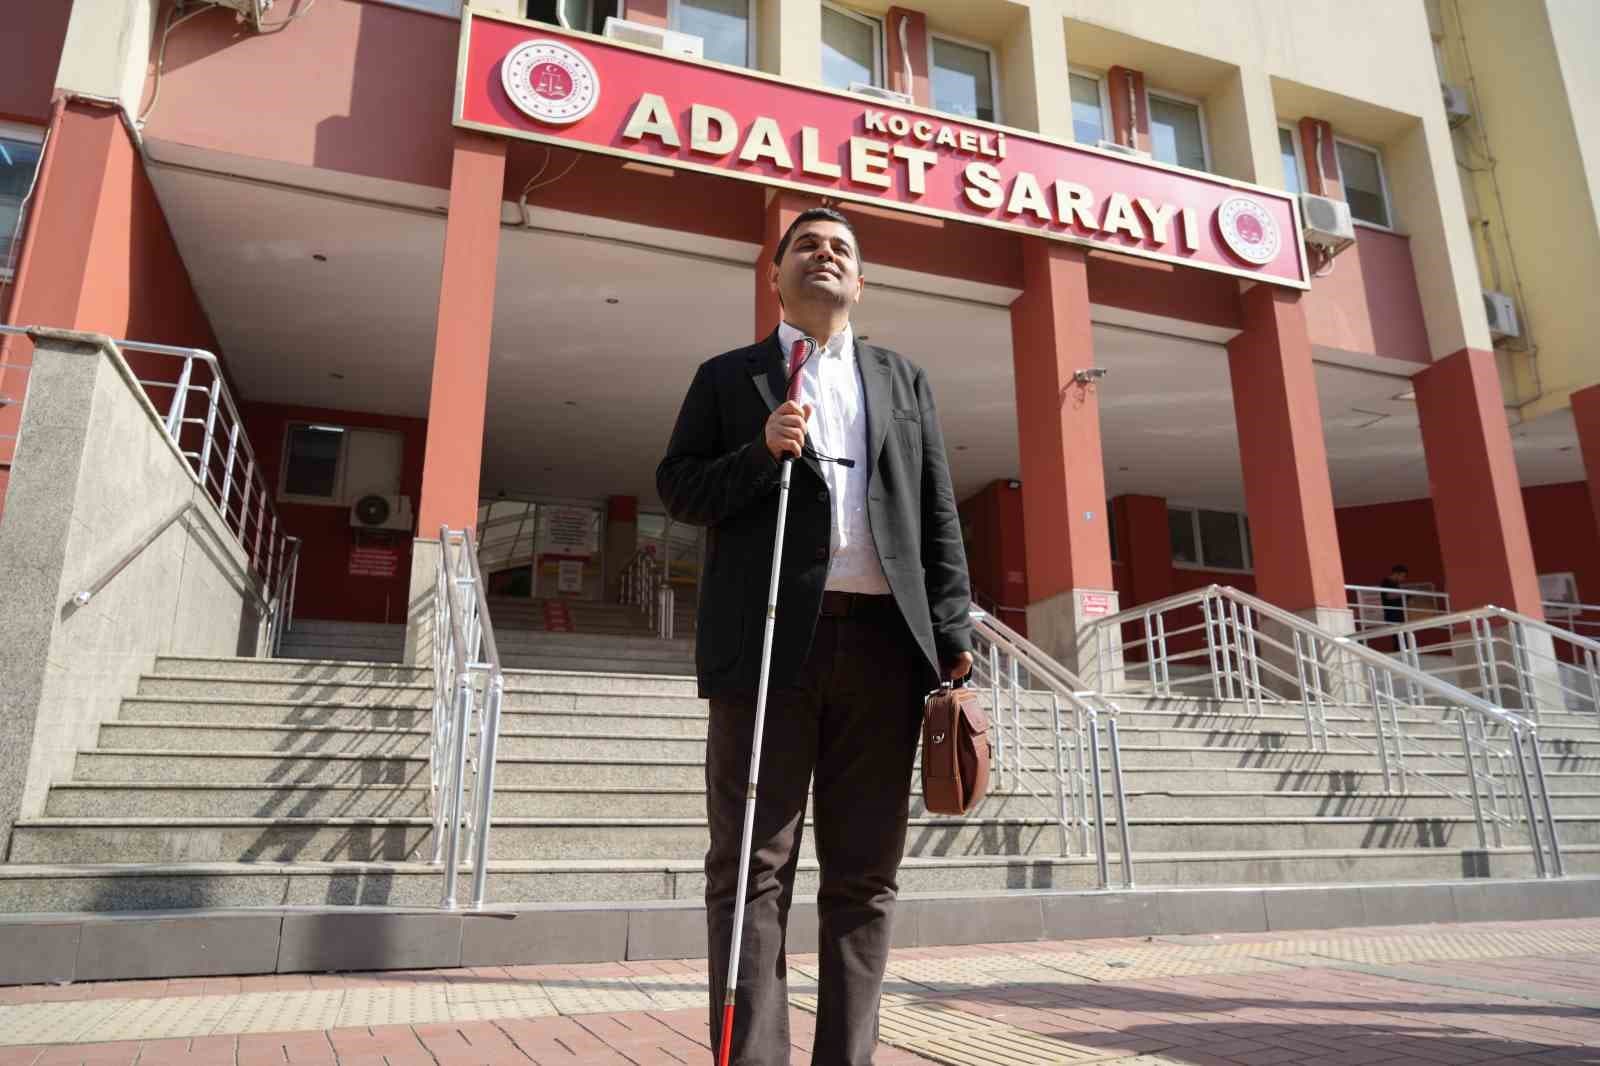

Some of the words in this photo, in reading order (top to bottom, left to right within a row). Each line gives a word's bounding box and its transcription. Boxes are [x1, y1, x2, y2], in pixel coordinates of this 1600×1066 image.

[622, 92, 937, 195] ADALET
[963, 162, 1198, 251] SARAYI
[864, 109, 1006, 158] KOCAELİ
